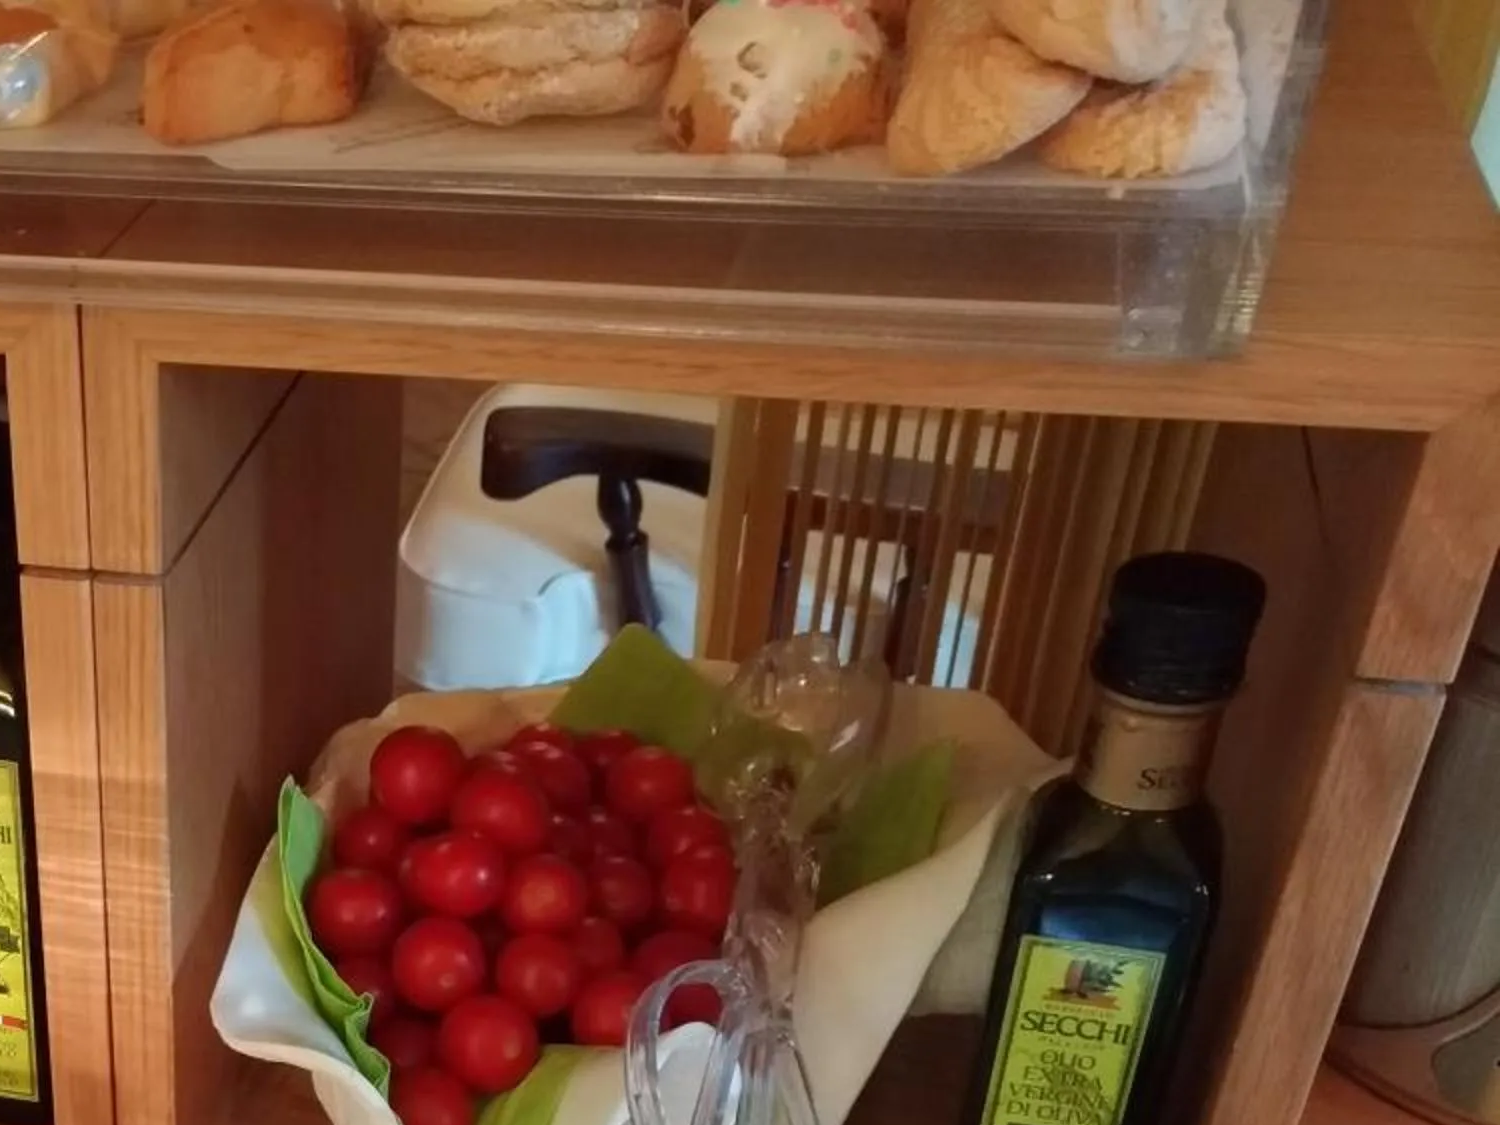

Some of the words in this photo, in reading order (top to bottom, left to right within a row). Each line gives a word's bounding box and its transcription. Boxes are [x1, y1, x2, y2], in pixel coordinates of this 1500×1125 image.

[1020, 1009, 1132, 1046] SECCHI
[1040, 1048, 1097, 1071] OLIO
[1006, 1101, 1031, 1117] DI
